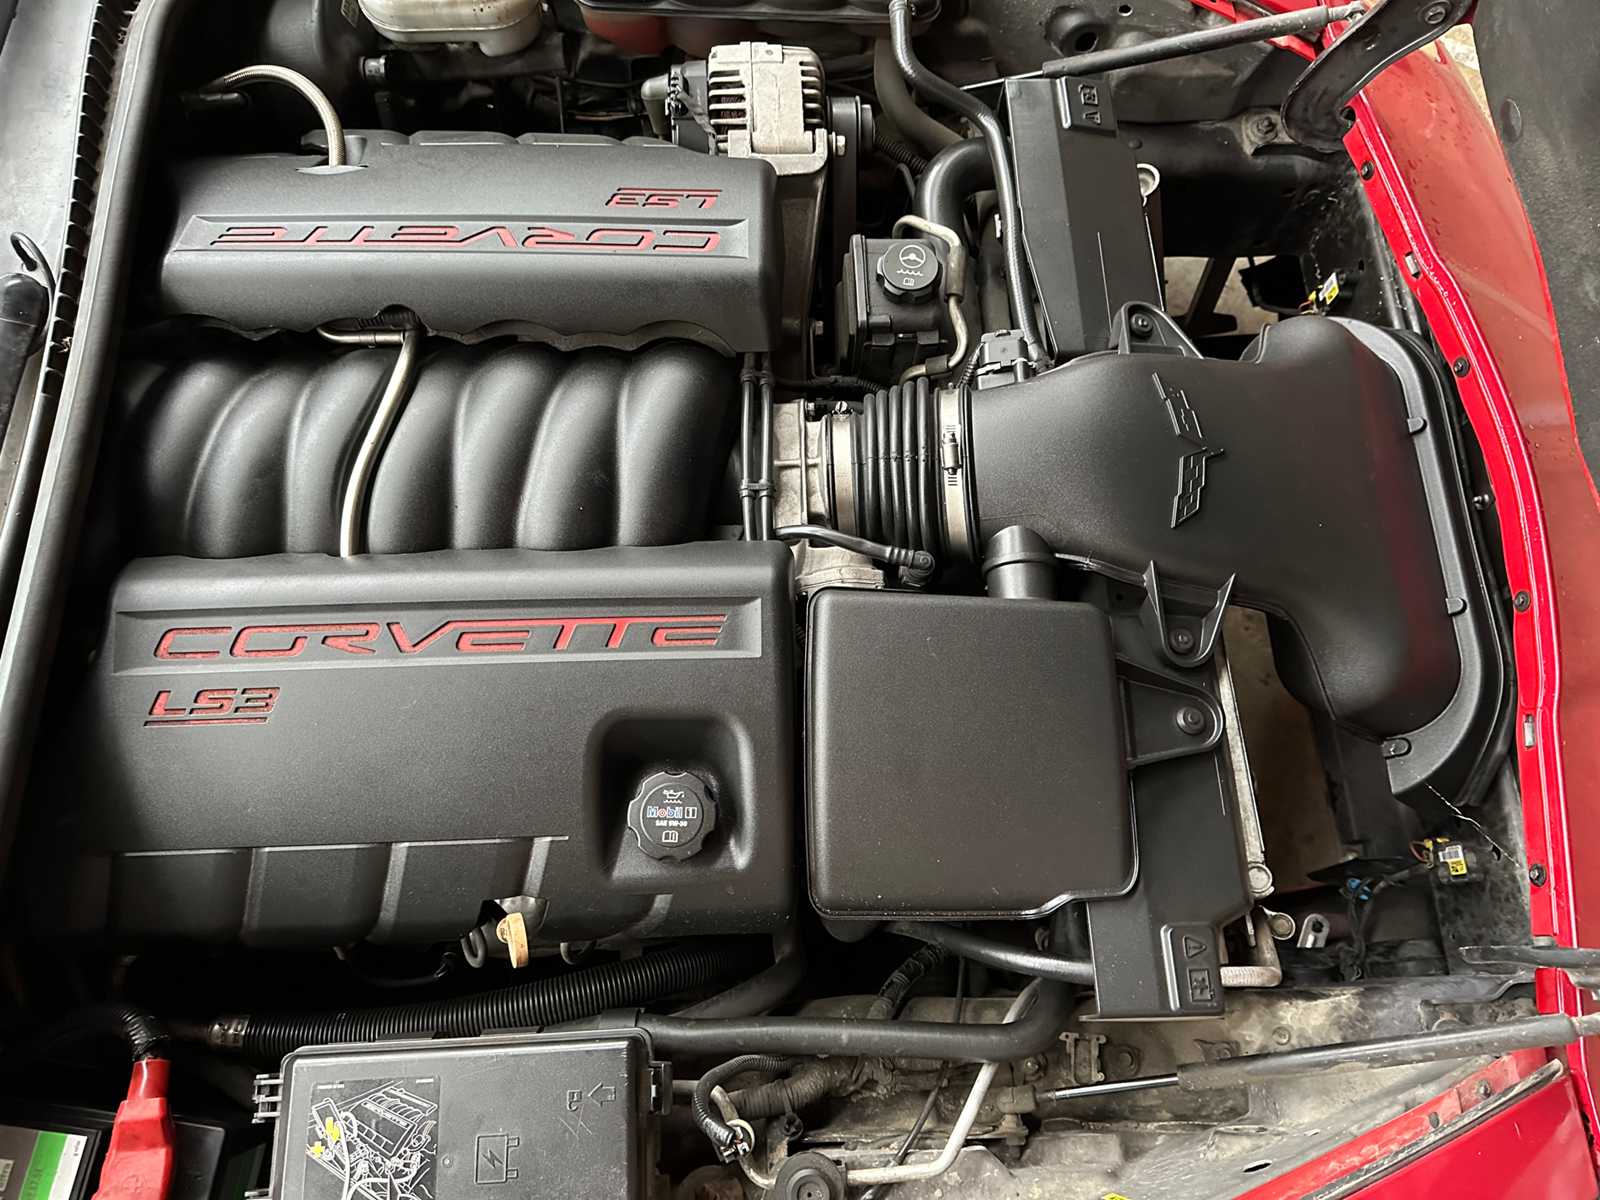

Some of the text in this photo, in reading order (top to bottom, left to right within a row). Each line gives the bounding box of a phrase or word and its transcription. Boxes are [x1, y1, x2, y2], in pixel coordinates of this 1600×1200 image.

[606, 191, 720, 209] LS3
[210, 224, 722, 253] CORVETTE
[154, 613, 728, 660] CORVETTE
[148, 686, 281, 717] LS3
[647, 806, 683, 818] Mobil
